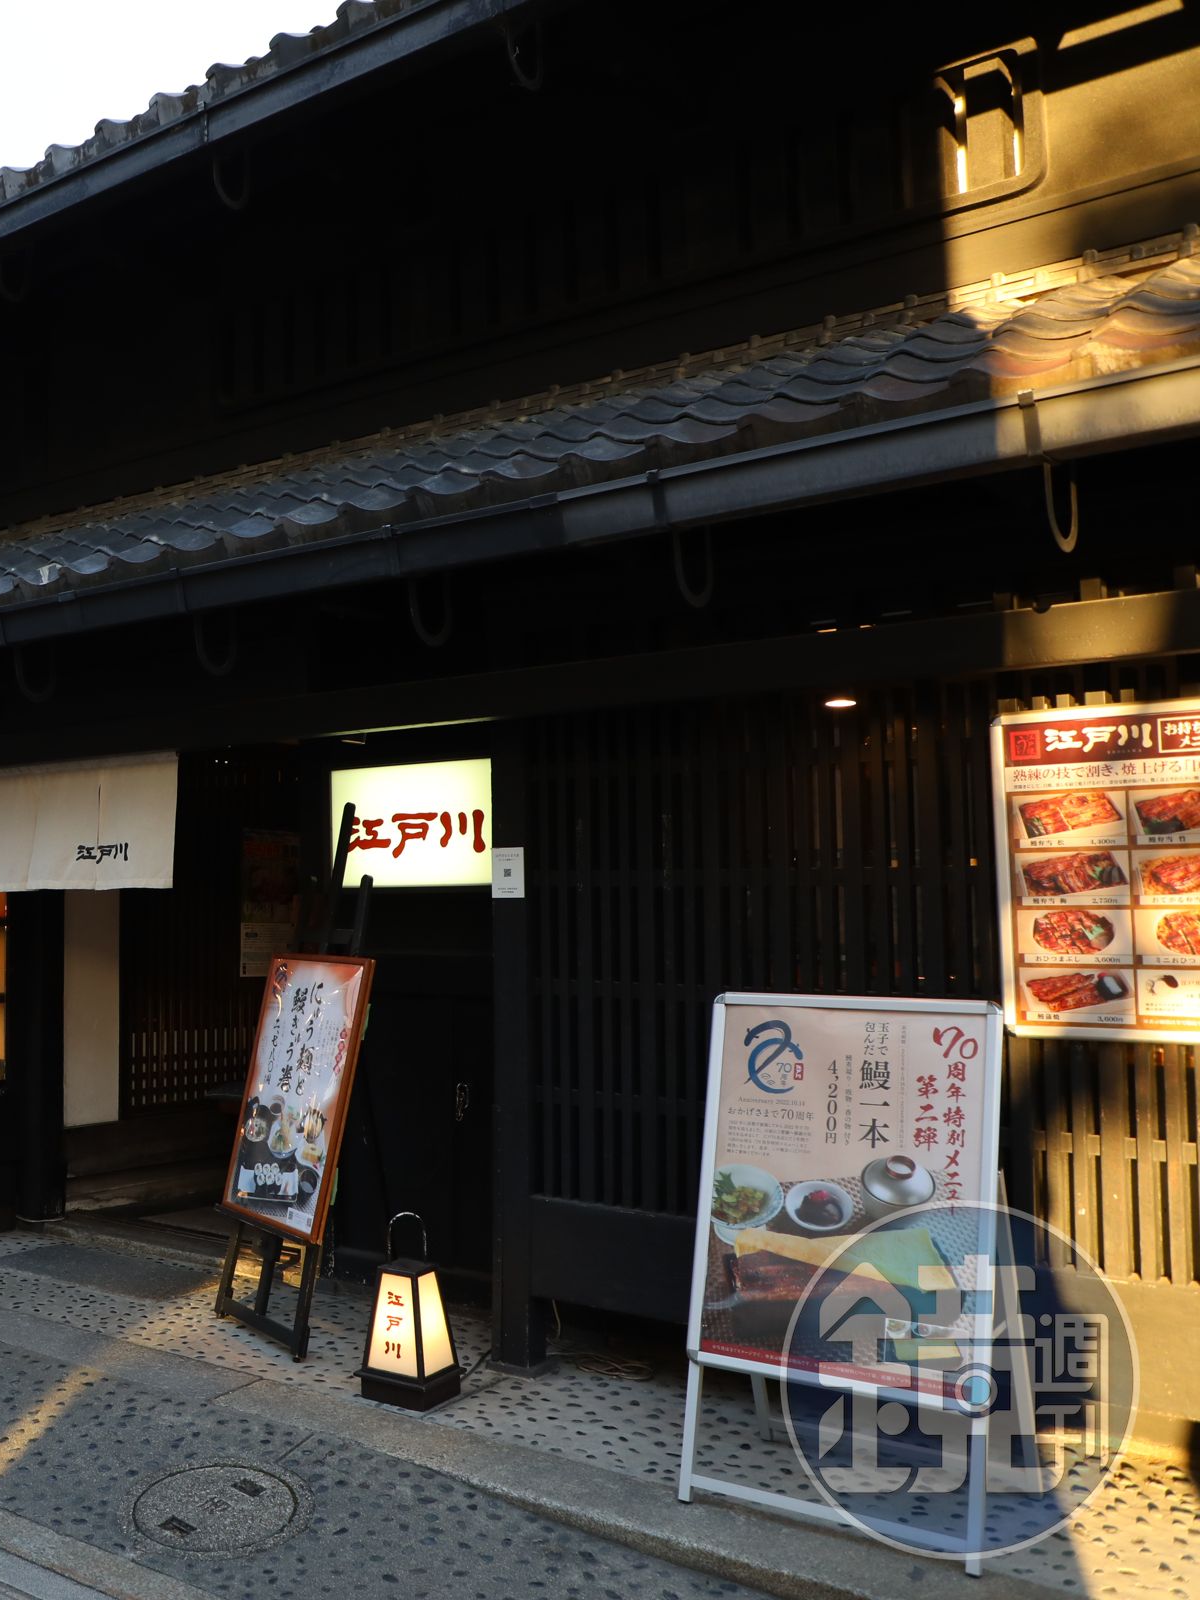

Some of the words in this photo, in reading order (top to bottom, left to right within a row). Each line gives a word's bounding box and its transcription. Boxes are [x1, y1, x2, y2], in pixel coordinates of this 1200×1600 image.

[1044, 723, 1153, 753] 江戸川
[348, 809, 486, 858] 江戸川
[76, 842, 128, 864] 江戸川
[863, 1022, 876, 1056] 包んだ
[877, 1022, 890, 1056] 玉子で
[727, 1107, 814, 1121] おかげさまで70周年
[825, 1059, 838, 1144] 4,200円
[858, 1060, 891, 1148] 鰻一本
[385, 1291, 404, 1359] 江戸川
